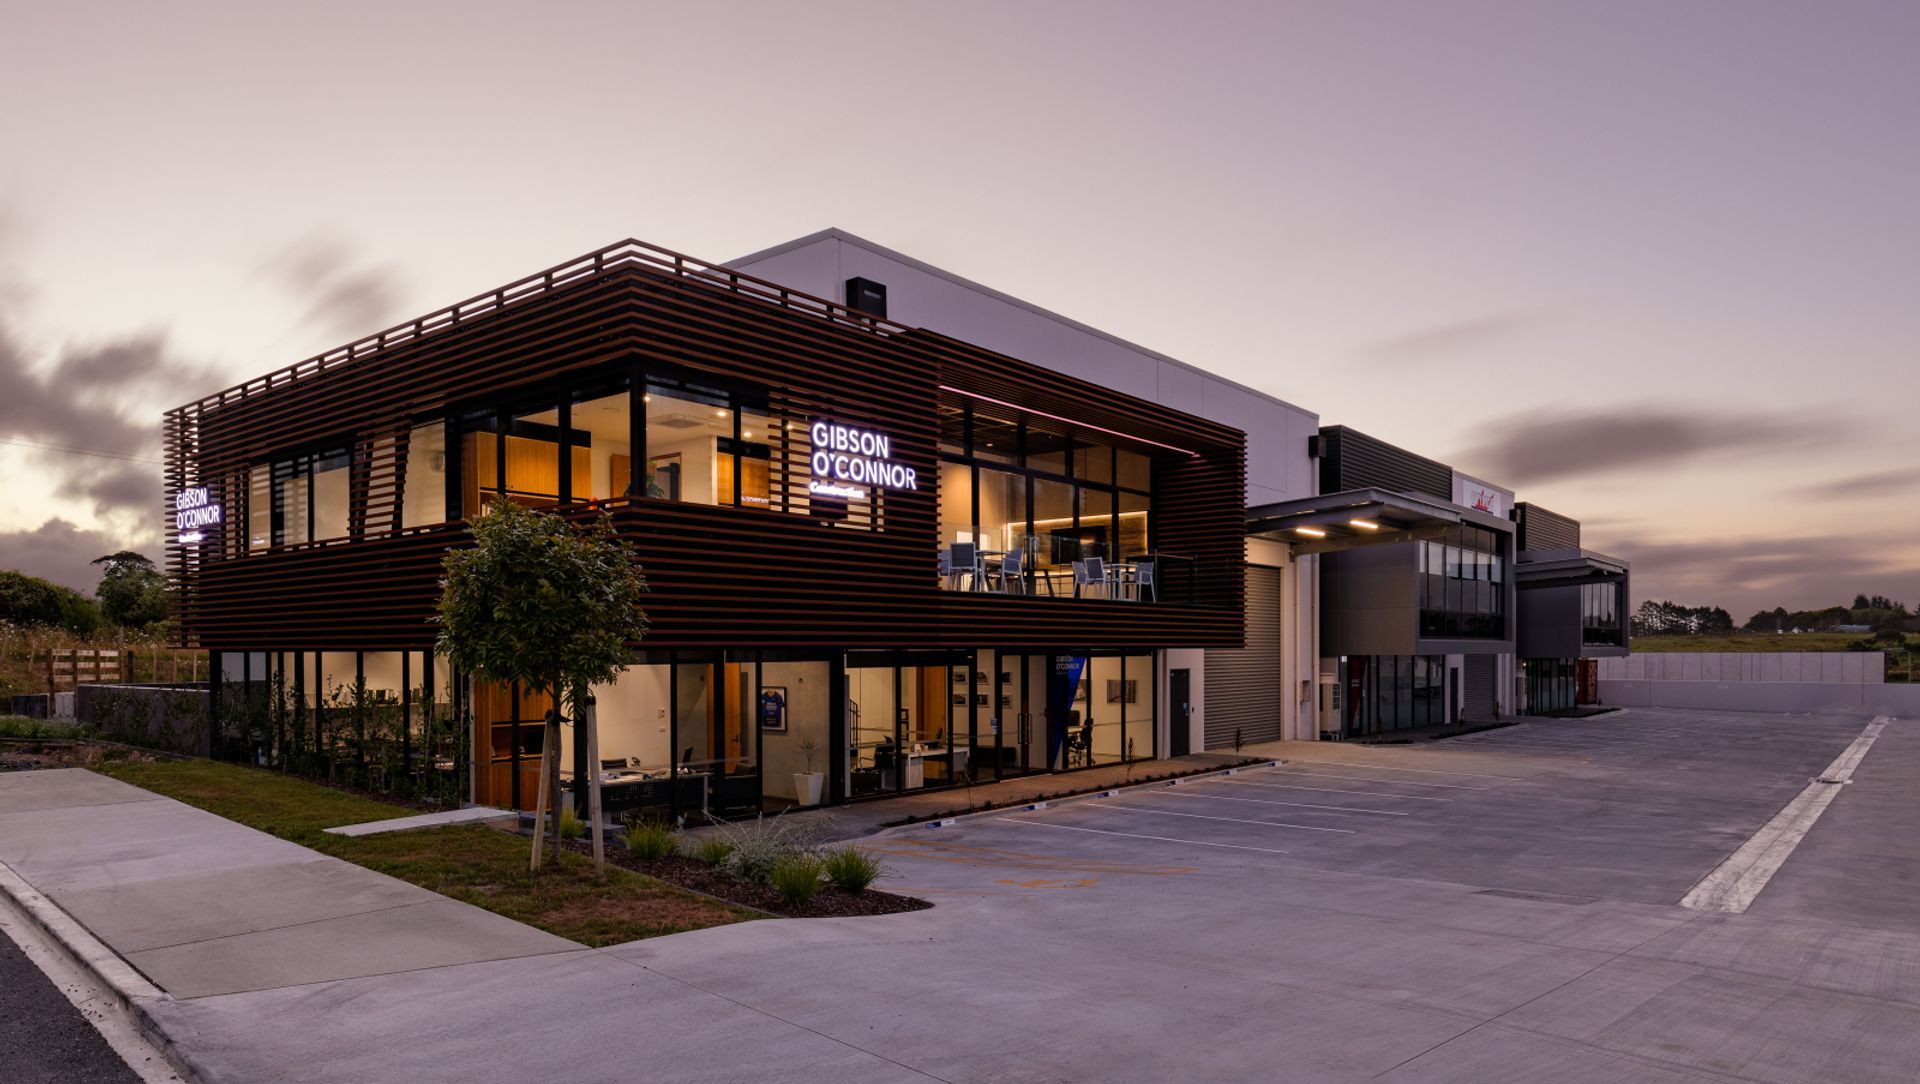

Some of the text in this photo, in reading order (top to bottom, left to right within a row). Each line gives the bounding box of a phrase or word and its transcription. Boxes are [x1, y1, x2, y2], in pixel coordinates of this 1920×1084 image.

[812, 422, 889, 458] GIBSON
[812, 451, 917, 490] O'CONNOR
[177, 488, 207, 510] GIBSON
[177, 505, 220, 529] O'CONNOR
